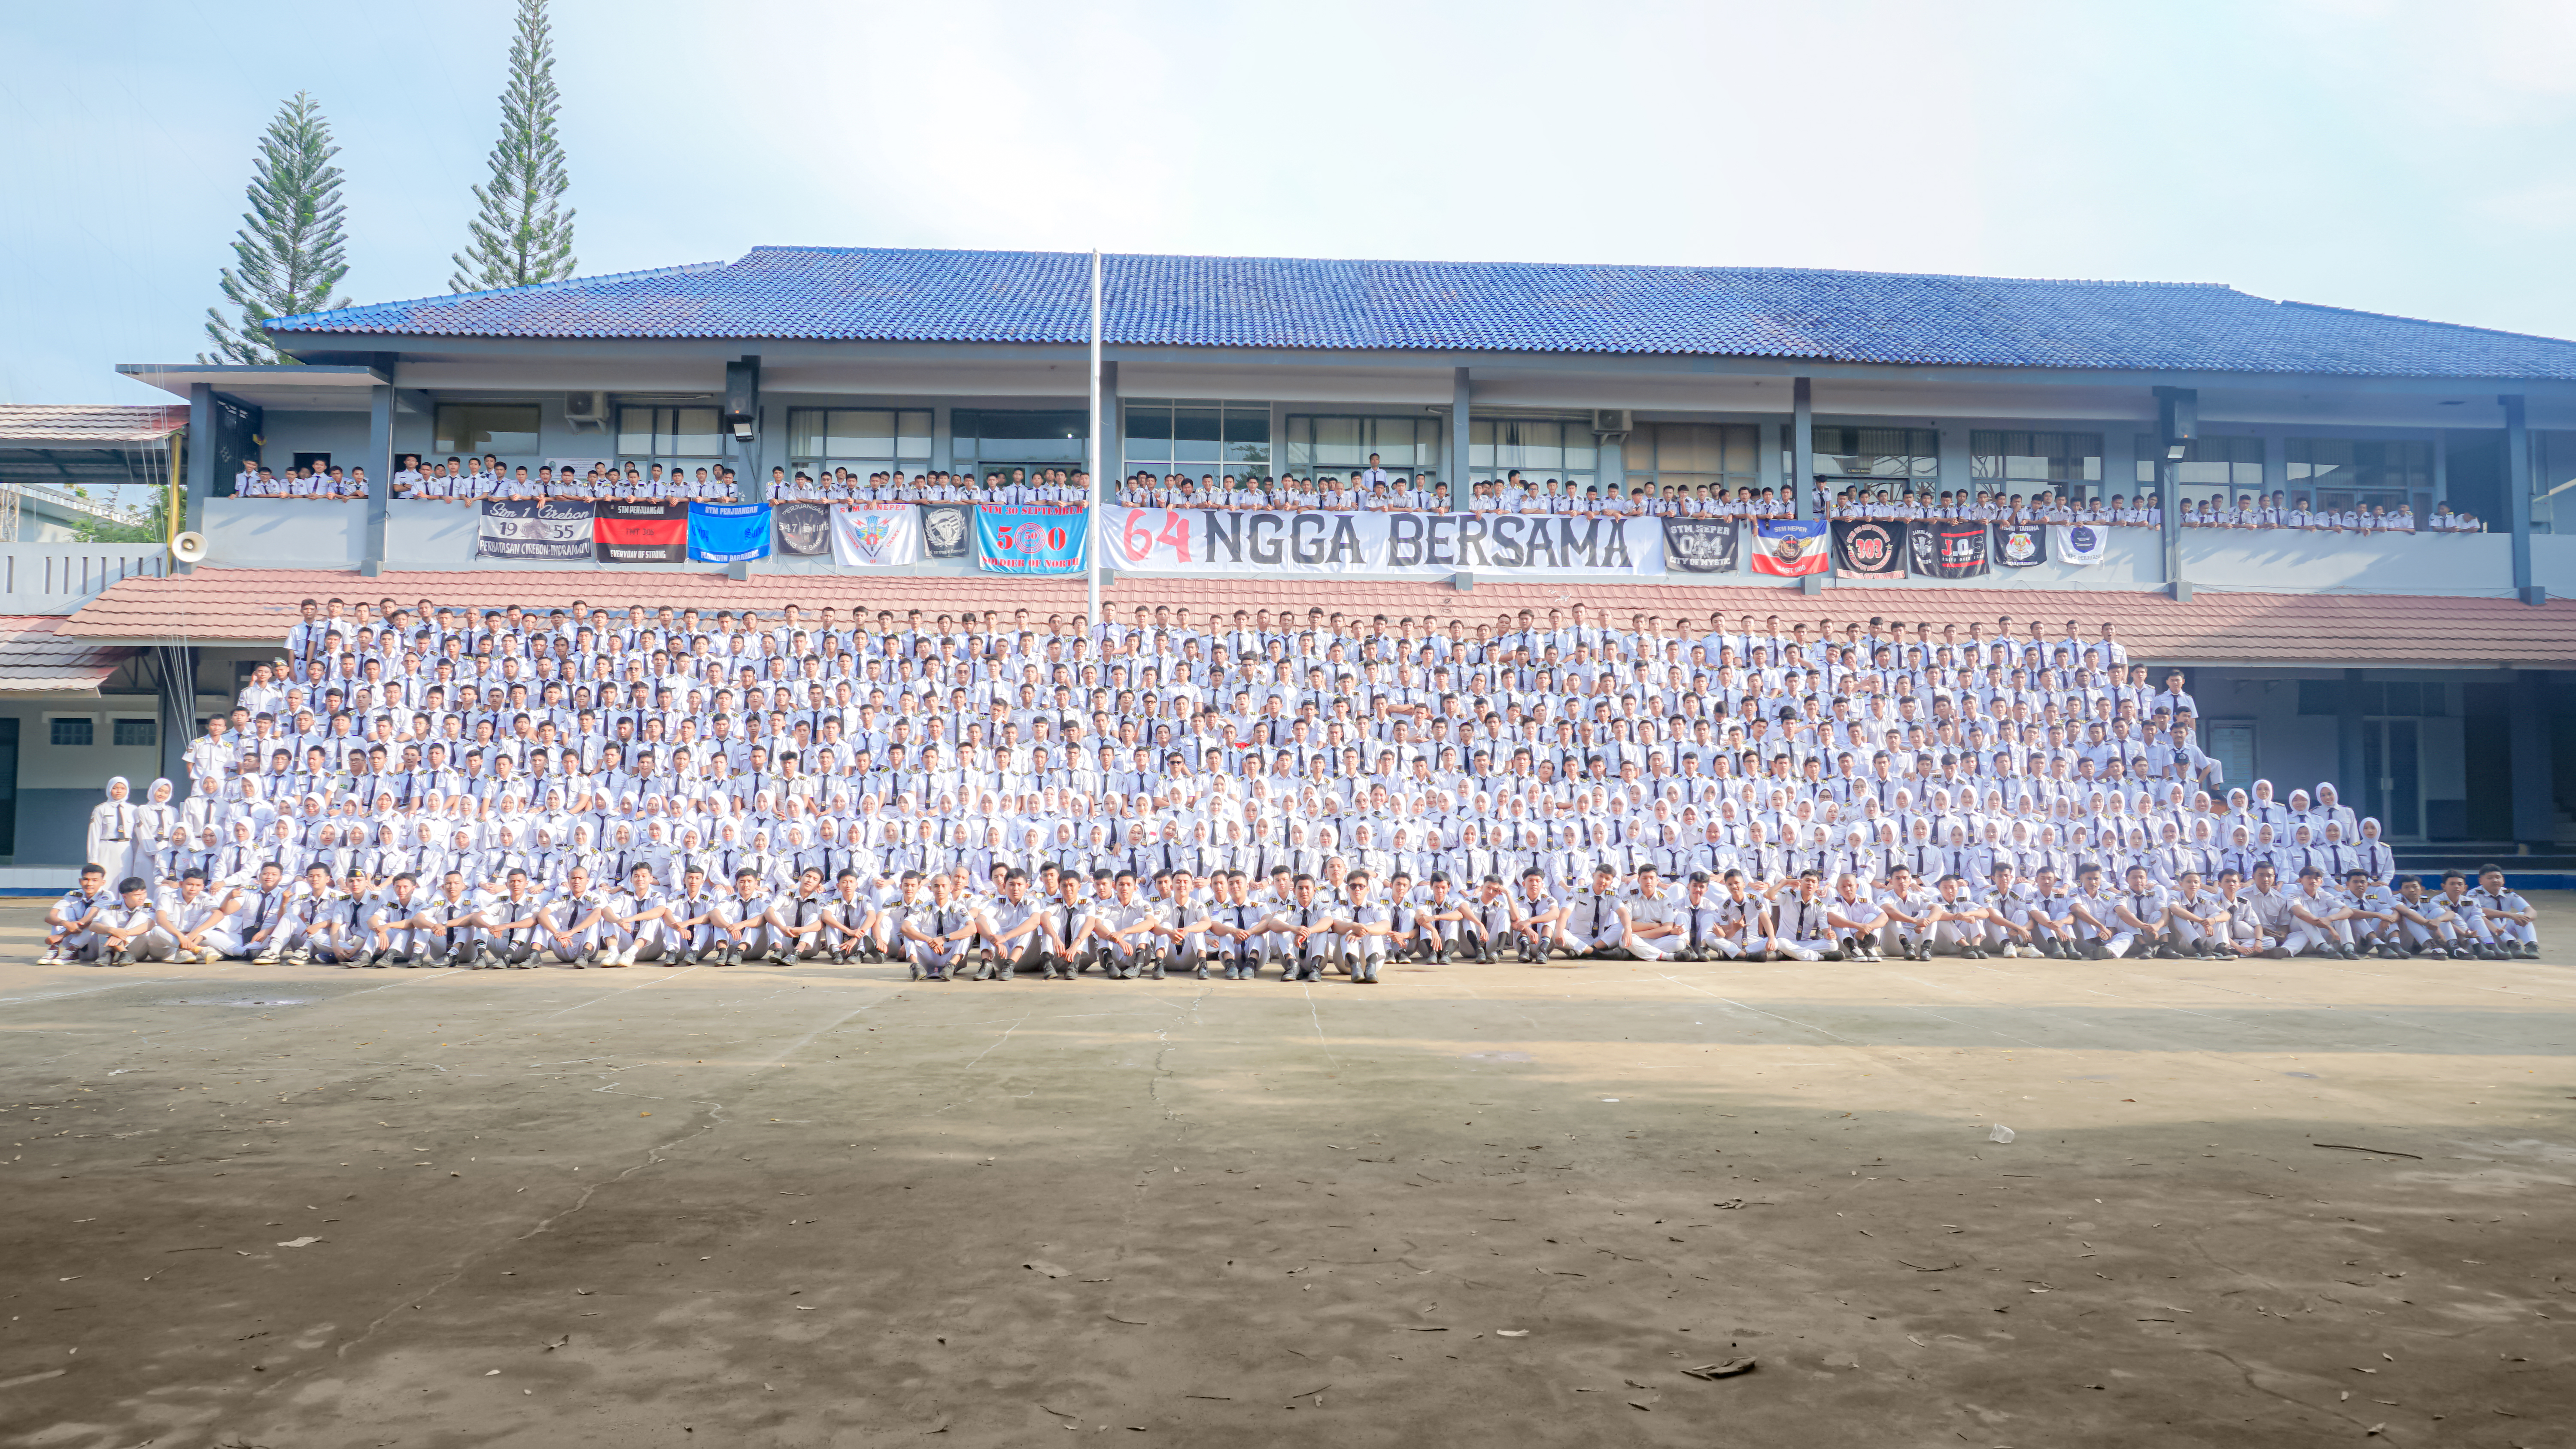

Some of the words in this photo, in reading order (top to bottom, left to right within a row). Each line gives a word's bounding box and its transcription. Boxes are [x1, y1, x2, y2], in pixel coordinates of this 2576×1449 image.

[490, 502, 516, 518] Stm
[522, 507, 531, 518] 1
[538, 504, 589, 519] Cirebon
[618, 506, 629, 514] STM
[629, 506, 664, 514] PERJUANGAN
[705, 506, 719, 515] STM
[720, 506, 758, 515] PERJUANGAN
[782, 503, 824, 515] PERJUANGAN
[840, 505, 860, 513] SM
[981, 504, 1002, 514] STM
[1021, 506, 1083, 515] SEPTEMBER
[500, 522, 518, 536] 19
[553, 525, 574, 539] 55
[778, 522, 798, 533] 547
[1670, 525, 1693, 534] STM
[1696, 525, 1730, 536] NEPER
[886, 529, 900, 547] CRAZY
[1847, 530, 1856, 544] STM
[1862, 524, 1890, 543] SEPTEMBER
[784, 537, 797, 548] KING
[808, 537, 823, 550] BASE
[1388, 513, 1634, 568] BERSAMA
[480, 540, 520, 555] PERBATASAN
[610, 549, 638, 558] EVERYDAY
[645, 550, 666, 558] STRONG
[1856, 538, 1883, 559] 303
[982, 556, 1025, 567] SOLDIER
[1028, 559, 1041, 568] OF
[1045, 557, 1080, 568] NORTH
[1670, 556, 1689, 565] CITY
[1794, 564, 1806, 573] 900
